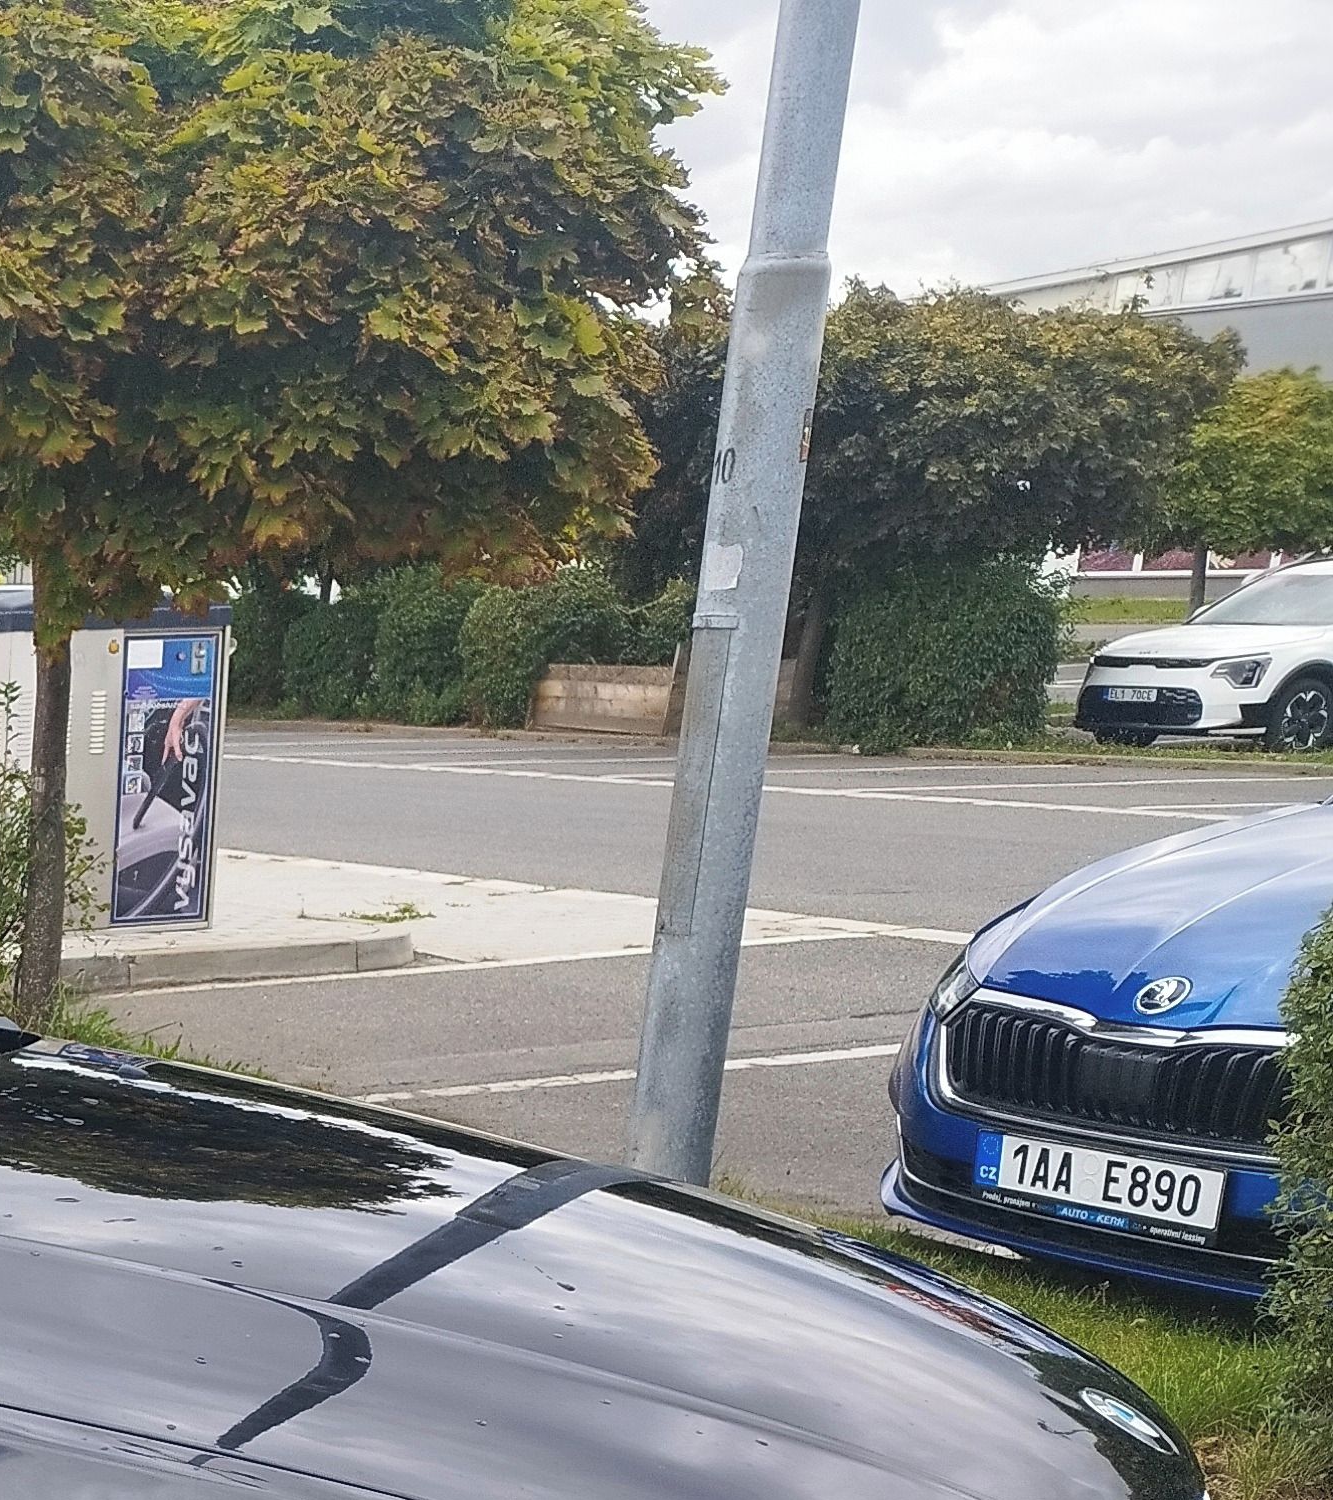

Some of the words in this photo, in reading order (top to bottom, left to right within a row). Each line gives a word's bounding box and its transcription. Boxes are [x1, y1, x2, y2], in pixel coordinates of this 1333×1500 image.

[174, 729, 203, 911] vysavač
[980, 1165, 997, 1181] CZ
[1012, 1144, 1073, 1194] 1AA
[1101, 1159, 1202, 1217] E890
[1061, 1207, 1088, 1220] AUTO
[1096, 1214, 1125, 1228] KERN
